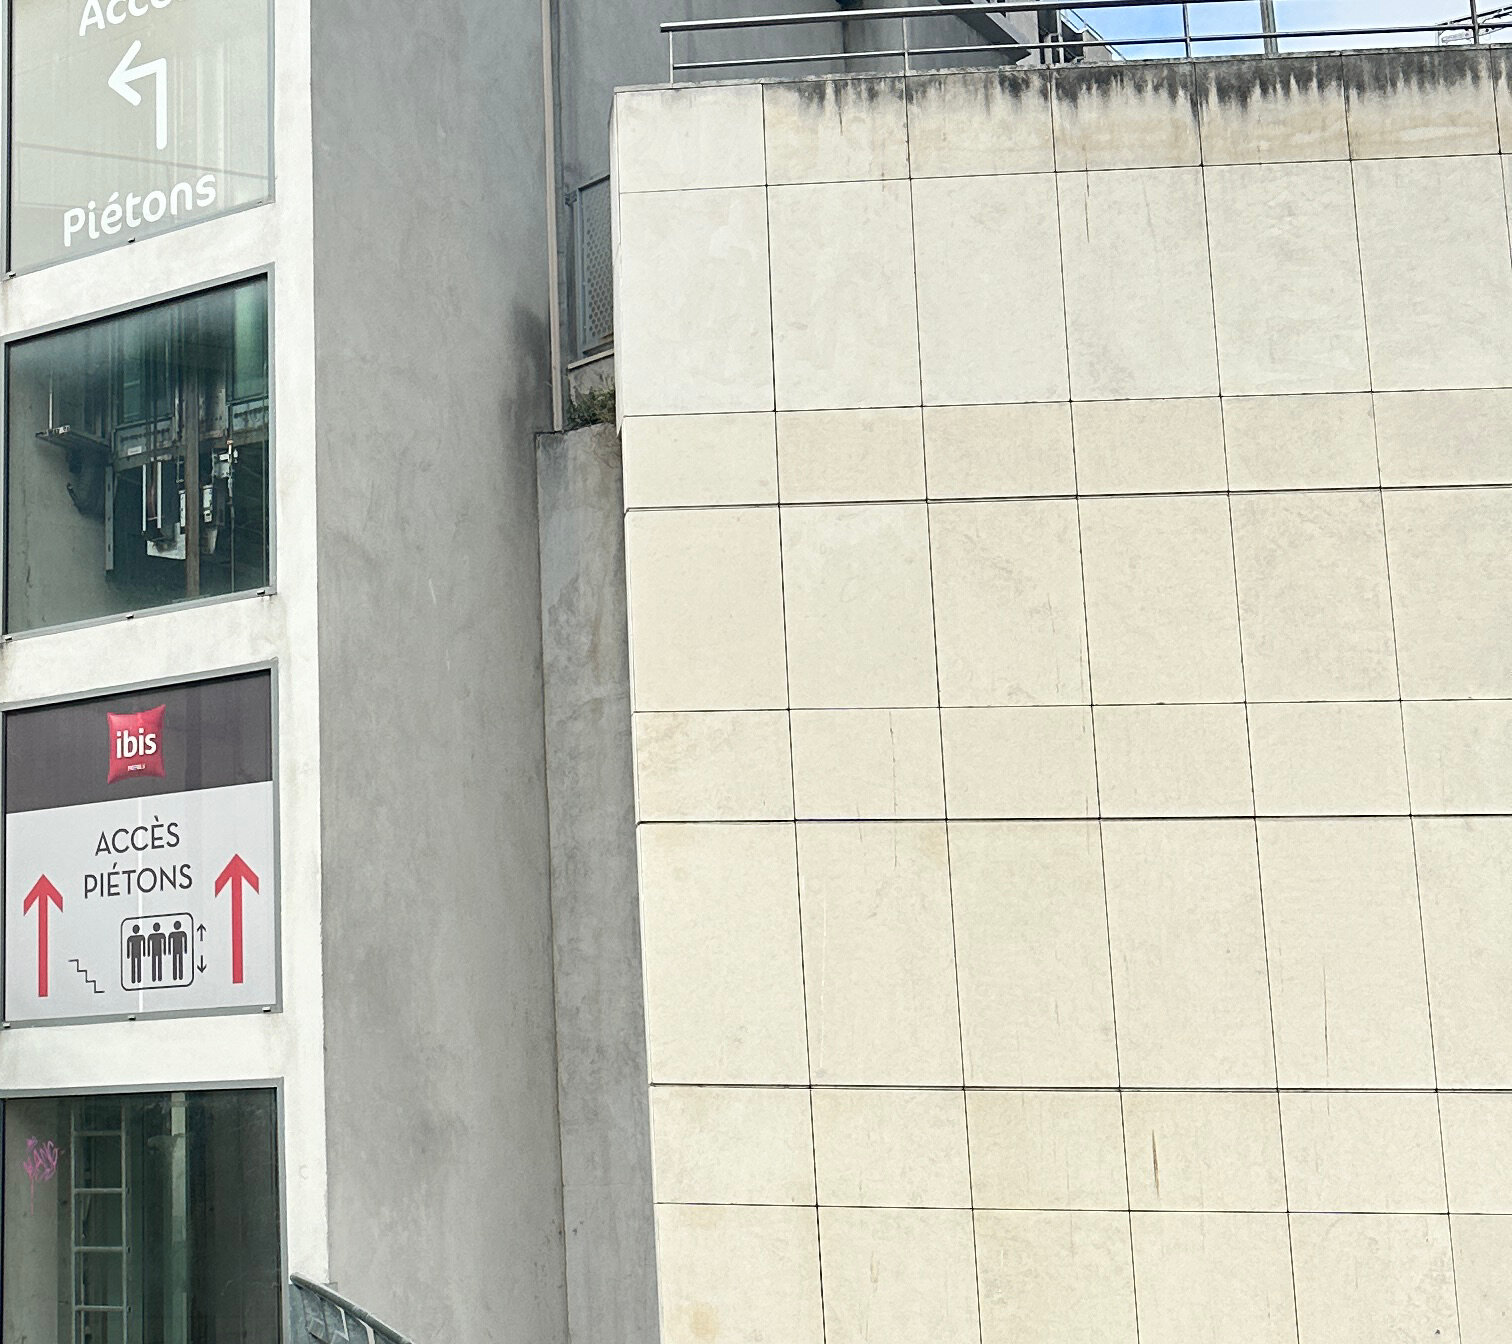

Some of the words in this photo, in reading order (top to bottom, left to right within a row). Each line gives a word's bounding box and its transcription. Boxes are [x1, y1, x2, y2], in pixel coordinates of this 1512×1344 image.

[63, 174, 216, 247] Piétons
[116, 728, 157, 759] ibis
[94, 815, 180, 856] ACCÈS
[84, 862, 193, 899] PIÉTONS
